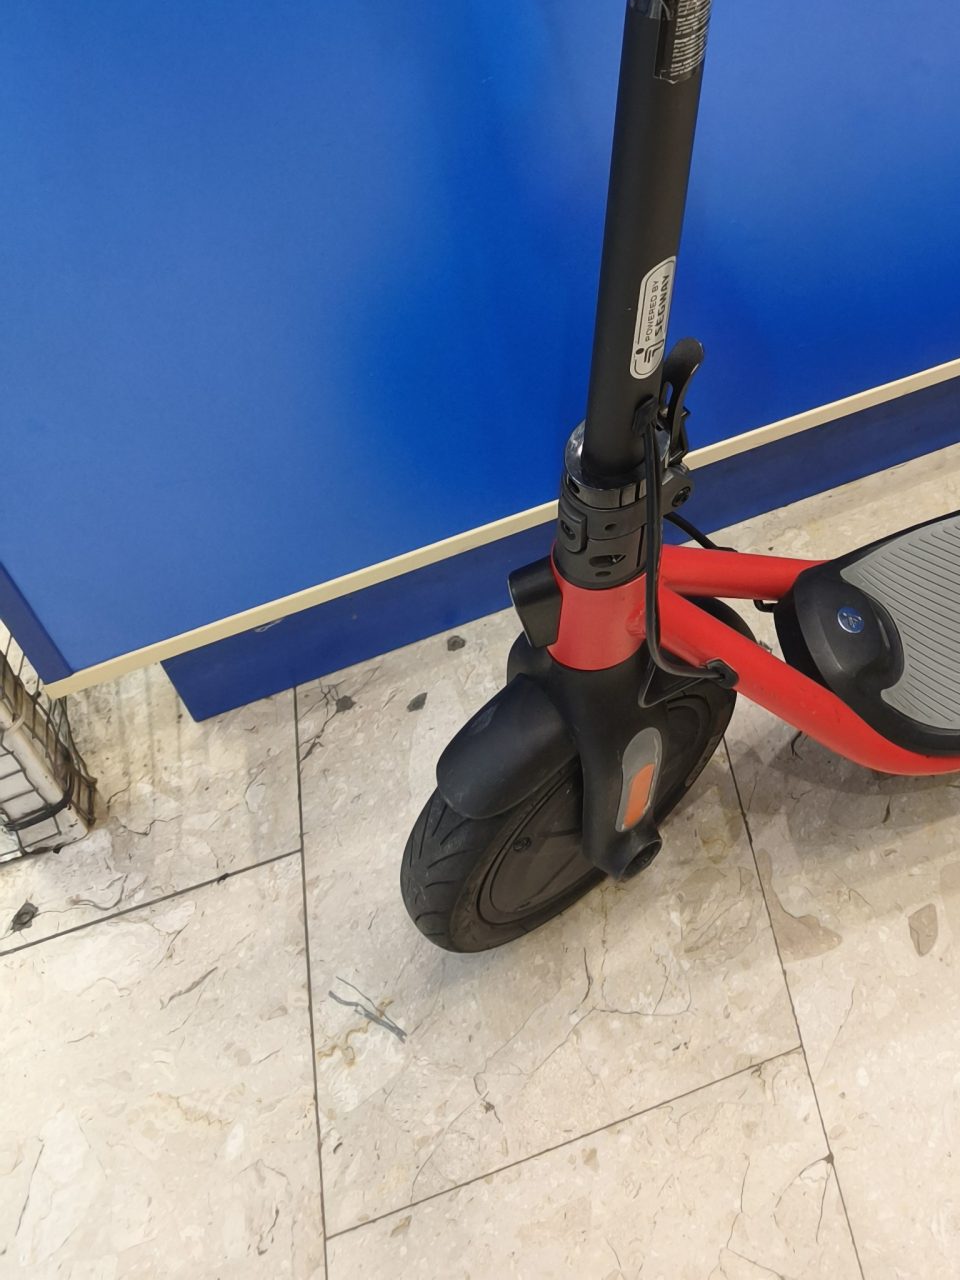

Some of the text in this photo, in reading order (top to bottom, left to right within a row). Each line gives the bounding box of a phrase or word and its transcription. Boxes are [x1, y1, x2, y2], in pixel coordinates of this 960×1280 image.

[645, 280, 659, 341] POWERED BY
[655, 275, 669, 336] SEGWAY
